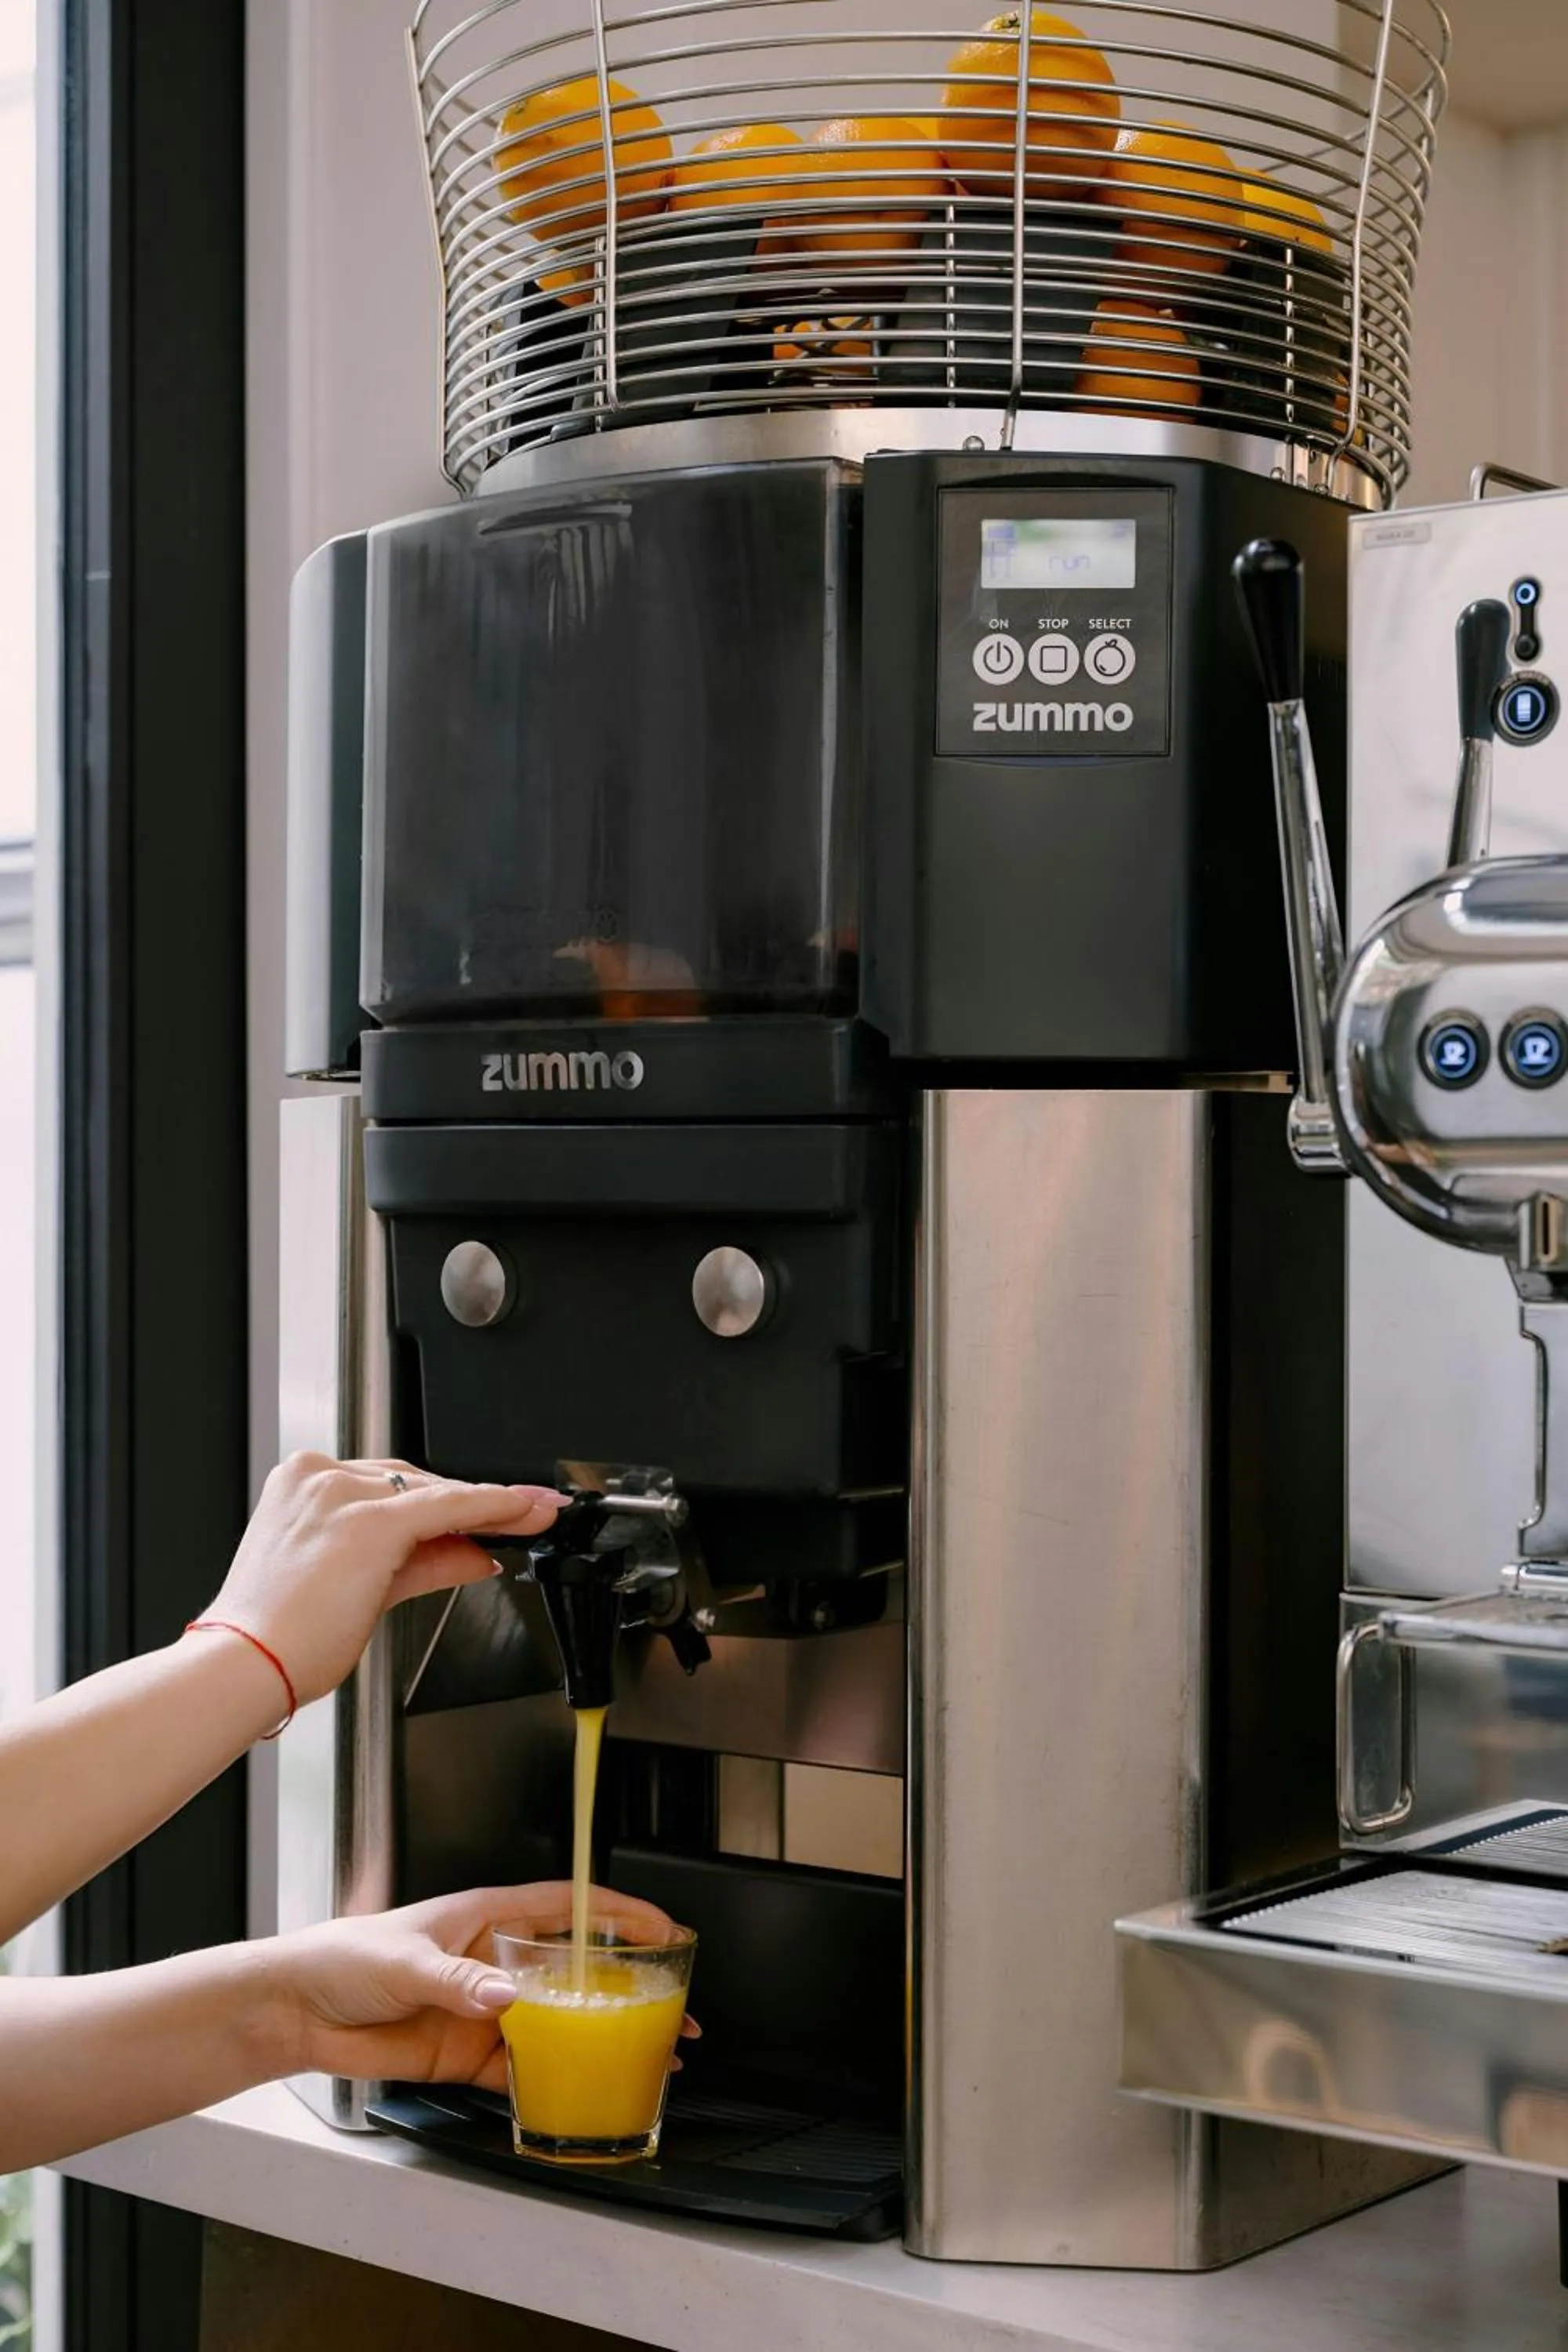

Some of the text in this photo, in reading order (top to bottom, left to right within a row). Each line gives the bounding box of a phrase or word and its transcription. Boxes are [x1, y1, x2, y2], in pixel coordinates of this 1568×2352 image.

[989, 618, 1009, 629] ON
[1038, 618, 1069, 629] STOP
[1088, 618, 1131, 629] SELECT
[973, 702, 1134, 731] zummo
[481, 1051, 644, 1091] zummo
